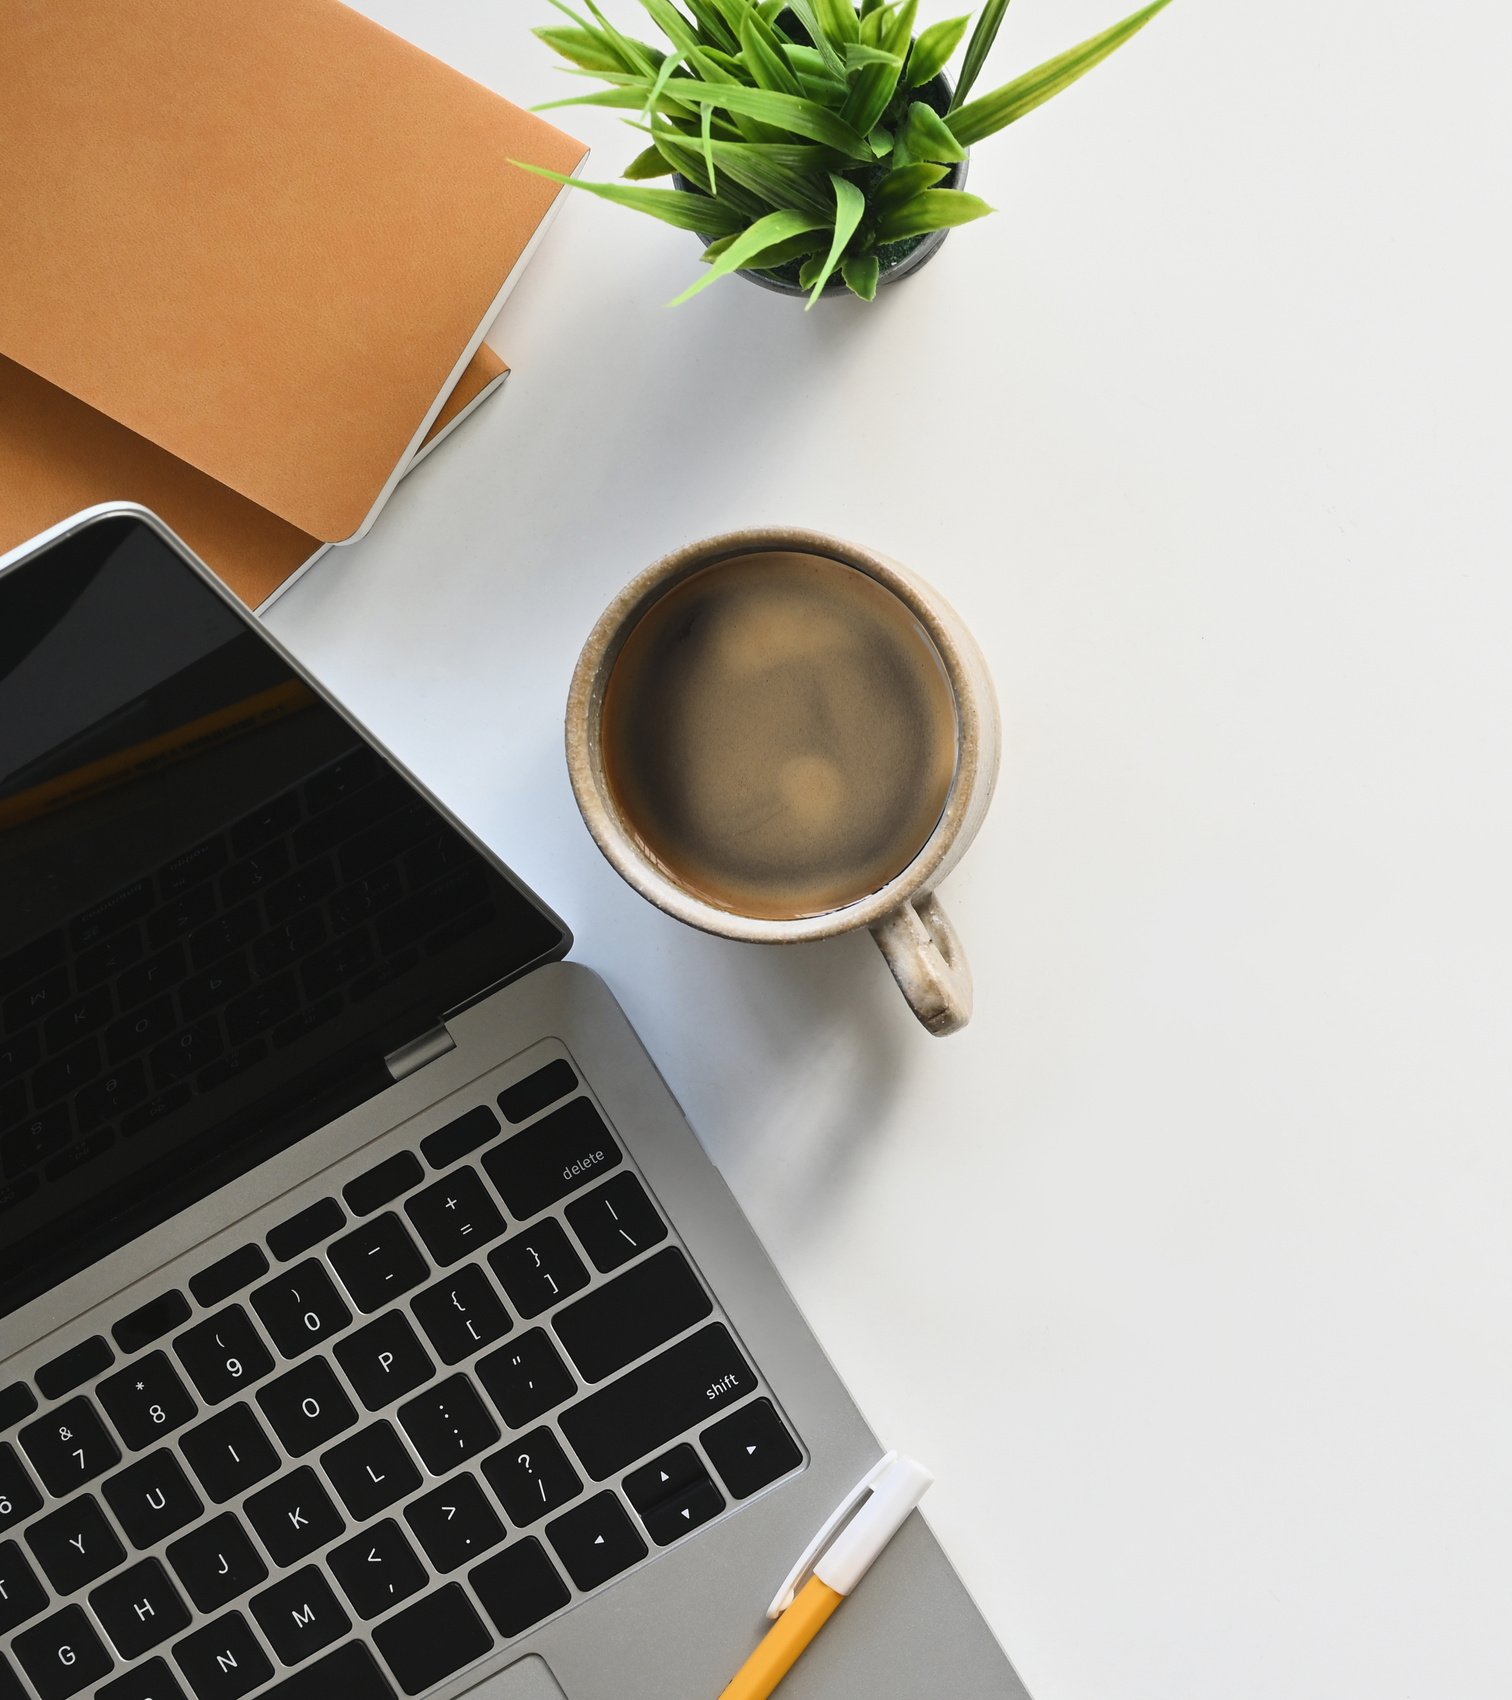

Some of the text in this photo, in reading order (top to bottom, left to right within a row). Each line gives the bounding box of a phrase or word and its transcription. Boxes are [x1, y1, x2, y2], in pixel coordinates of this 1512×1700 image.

[562, 1150, 605, 1181] delete
[445, 1197, 458, 1210] +
[460, 1223, 473, 1236] =
[618, 1229, 637, 1247] \
[525, 1246, 541, 1268] }
[543, 1273, 559, 1295] ]
[290, 1289, 301, 1303] )
[451, 1290, 466, 1312] {
[465, 1319, 482, 1341] [
[215, 1334, 225, 1348] (
[226, 1357, 243, 1378] 9
[377, 1351, 394, 1373] P
[706, 1373, 740, 1400] shift
[149, 1404, 166, 1424] 8
[301, 1397, 321, 1418] O
[58, 1426, 74, 1441] &
[71, 1448, 85, 1470] 7
[517, 1453, 533, 1474] ?
[365, 1465, 386, 1483] L
[145, 1487, 166, 1510] U
[537, 1478, 547, 1502] /
[287, 1506, 310, 1530] K
[441, 1506, 457, 1521] >
[68, 1533, 86, 1554] Y
[218, 1553, 229, 1575] J
[367, 1547, 382, 1562] <
[133, 1598, 155, 1622] H
[291, 1603, 316, 1629] M
[57, 1645, 76, 1666] G
[216, 1649, 238, 1673] N
